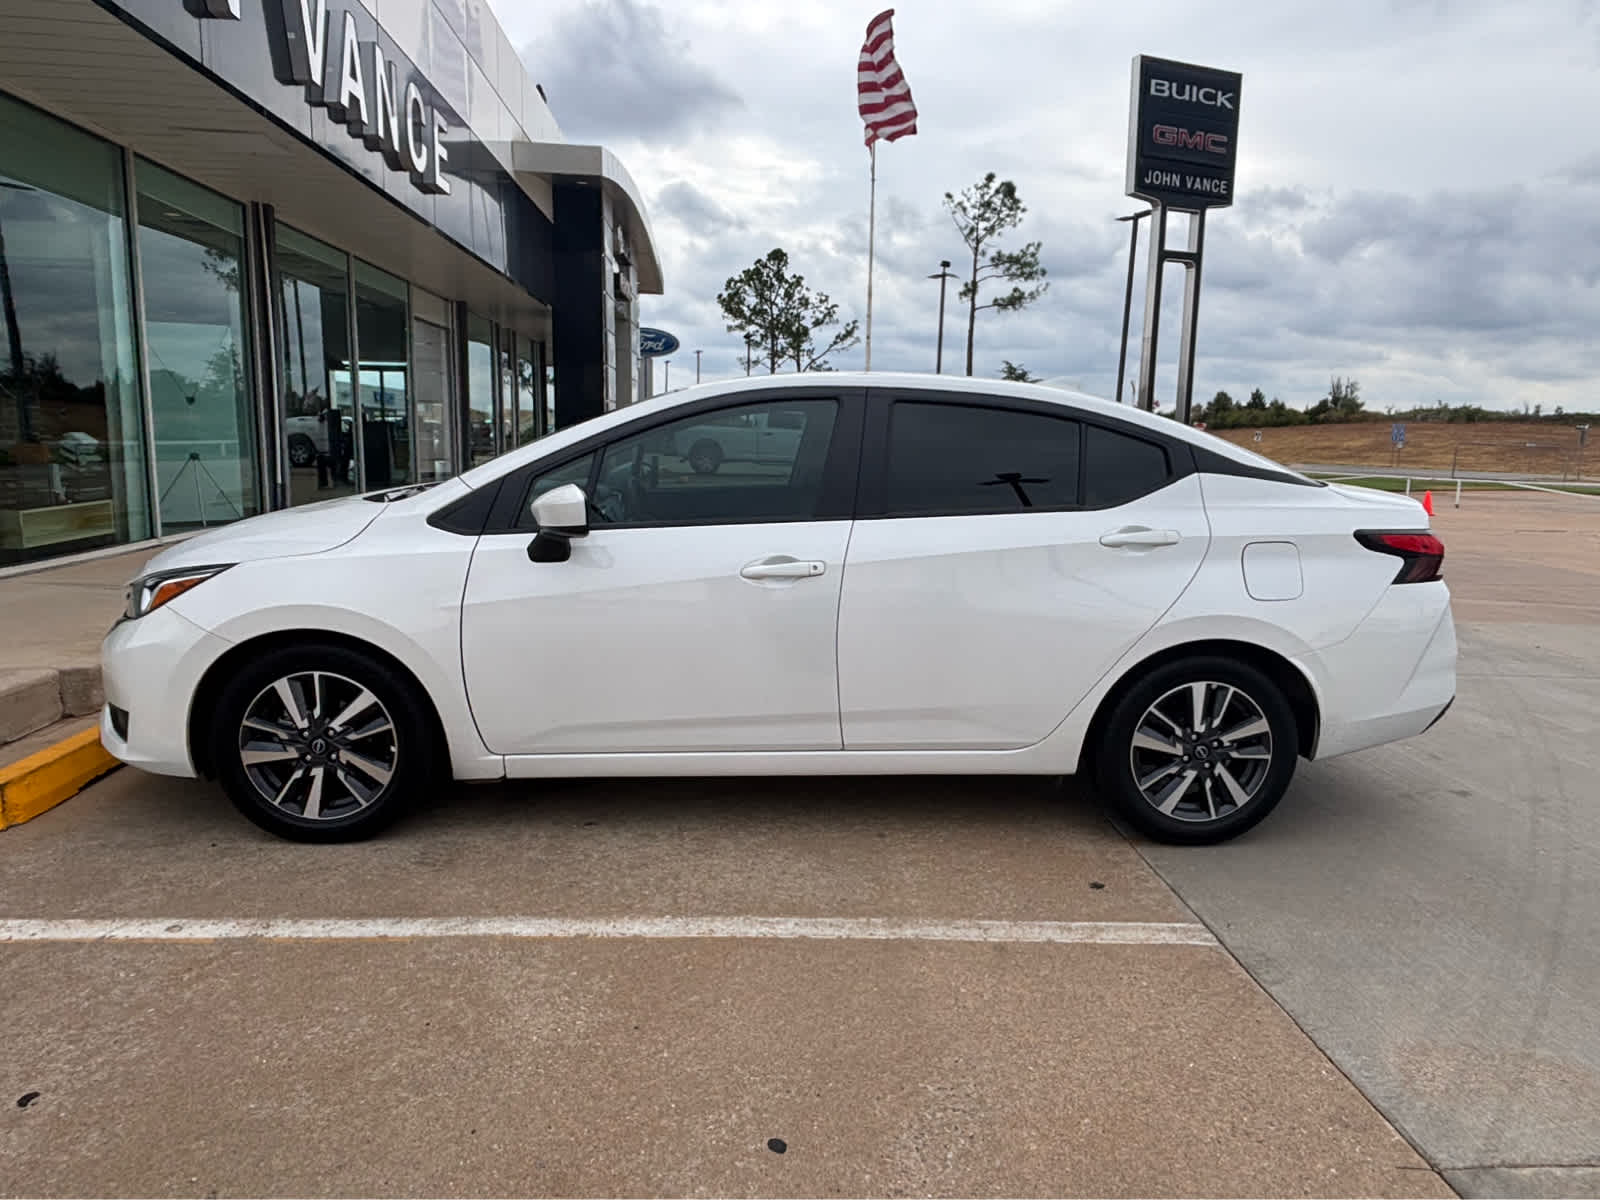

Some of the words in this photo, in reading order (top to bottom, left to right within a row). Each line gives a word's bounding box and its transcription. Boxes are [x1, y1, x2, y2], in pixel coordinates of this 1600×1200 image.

[300, 0, 451, 195] VANCE
[1150, 79, 1234, 110] BUICK
[1153, 124, 1228, 154] GMC
[1144, 169, 1181, 188] JOHN
[1185, 175, 1228, 194] VANCE
[640, 333, 665, 351] ord
